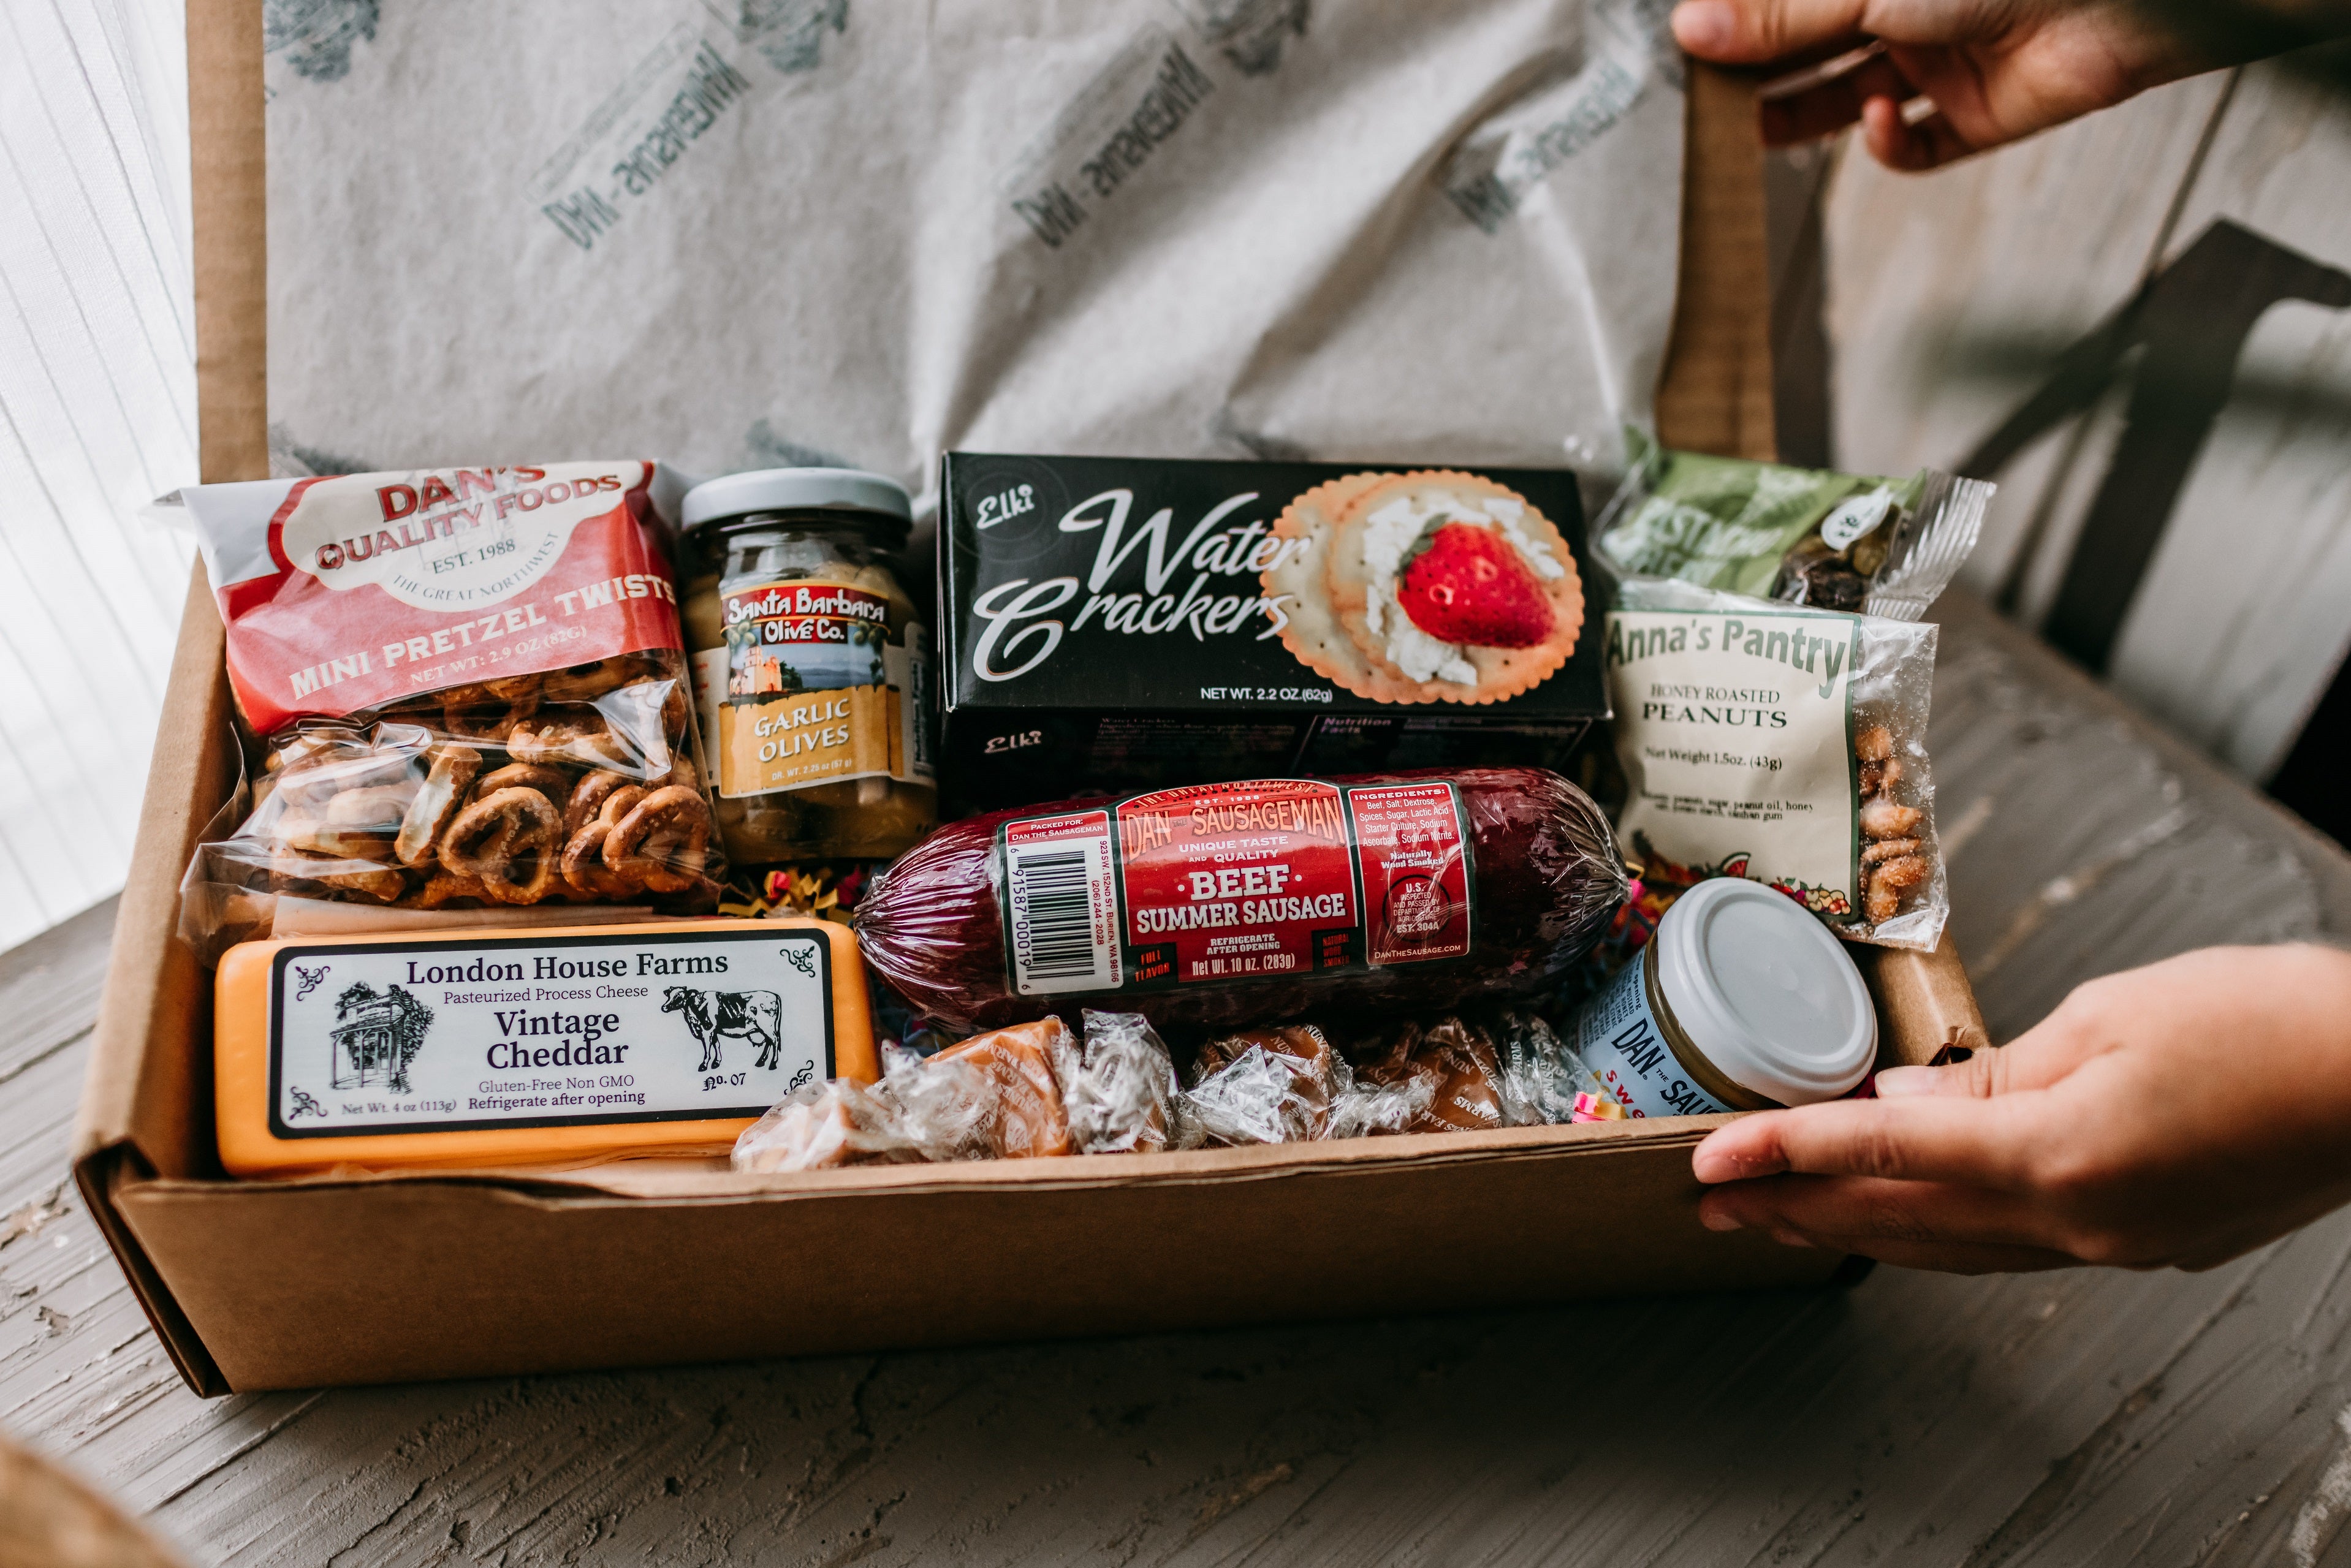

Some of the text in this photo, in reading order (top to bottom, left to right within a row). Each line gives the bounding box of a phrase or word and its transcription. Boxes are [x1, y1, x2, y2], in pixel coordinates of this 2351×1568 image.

[376, 465, 546, 522] DAN'S
[976, 483, 1035, 530] Elki
[315, 474, 621, 570] QUALITY FOODS
[1058, 488, 1313, 597] Water
[393, 531, 559, 601] THE GREAT NORTHWEST
[433, 538, 516, 574] EST. 1988
[291, 574, 677, 700] MINI PRETZEL TWISTS
[816, 619, 845, 640] Co.
[973, 572, 1294, 681] Crackers
[410, 625, 587, 686] NET WT: 2.9 OZ (82G)
[1606, 617, 1846, 699] Anna's Pantry
[1201, 687, 1227, 700] NET
[1230, 687, 1253, 700] WT.
[1257, 688, 1277, 700] 2.2
[1650, 683, 1780, 704] HONEY ROASTED
[754, 698, 850, 737] GARLIC
[1643, 702, 1787, 729] PEANUTS
[758, 724, 849, 763] OLIVES
[984, 730, 1041, 753] Elki
[1669, 749, 1710, 764] Weight
[1750, 756, 1782, 771] (43g)
[772, 771, 784, 781] DR.
[787, 768, 801, 778] WT.
[1135, 781, 1315, 808] THE GREAT NORTHWEST
[1354, 789, 1445, 800] INGREDIENTS:
[1367, 798, 1437, 810] Beef, Salt, Dextrose,
[1359, 806, 1449, 822] Spices, Sugar, Lactic Acid
[1123, 810, 1172, 862] DAN
[1191, 796, 1346, 846] SAUSAGEMAN
[1365, 819, 1448, 833] Starter Culture, Sodium
[1179, 835, 1288, 854] UNIQUE TASTE
[1363, 831, 1454, 847] Ascorbate, Sodium Nitrite.
[1101, 857, 1110, 870] SW.
[1213, 849, 1280, 864] QUALITY
[1390, 850, 1432, 860] Naturally
[1012, 869, 1027, 912] 91587
[1092, 880, 1100, 901] (206)
[1188, 864, 1289, 901] BEEF
[1405, 882, 1424, 893] U.S.
[1400, 892, 1432, 901] INSPECTED
[1137, 893, 1346, 934] SUMMER SAUSAGE
[1016, 922, 1031, 966] 00019
[1207, 941, 1280, 955] AFTER OPENING
[1210, 933, 1275, 947] REFRIGERATE
[1109, 945, 1117, 958] WA
[406, 953, 729, 984] London House Farms
[1111, 960, 1119, 982] 98166
[1193, 953, 1295, 976] Net Wt. 10 oz. (283g)
[444, 985, 648, 1004] Pasteurized Process Cheese
[1633, 974, 1642, 1010] opening
[494, 1009, 620, 1042] Vintage
[487, 1040, 629, 1069] Cheddar
[479, 1075, 634, 1094] Gluten-Free Non GMO
[731, 1072, 746, 1086] 07
[1656, 1068, 1669, 1082] THE
[341, 1104, 363, 1115] Net
[393, 1102, 400, 1112] 4
[403, 1104, 416, 1112] oz
[420, 1100, 457, 1114] (113g)
[468, 1091, 646, 1111] Refrigerate after opening
